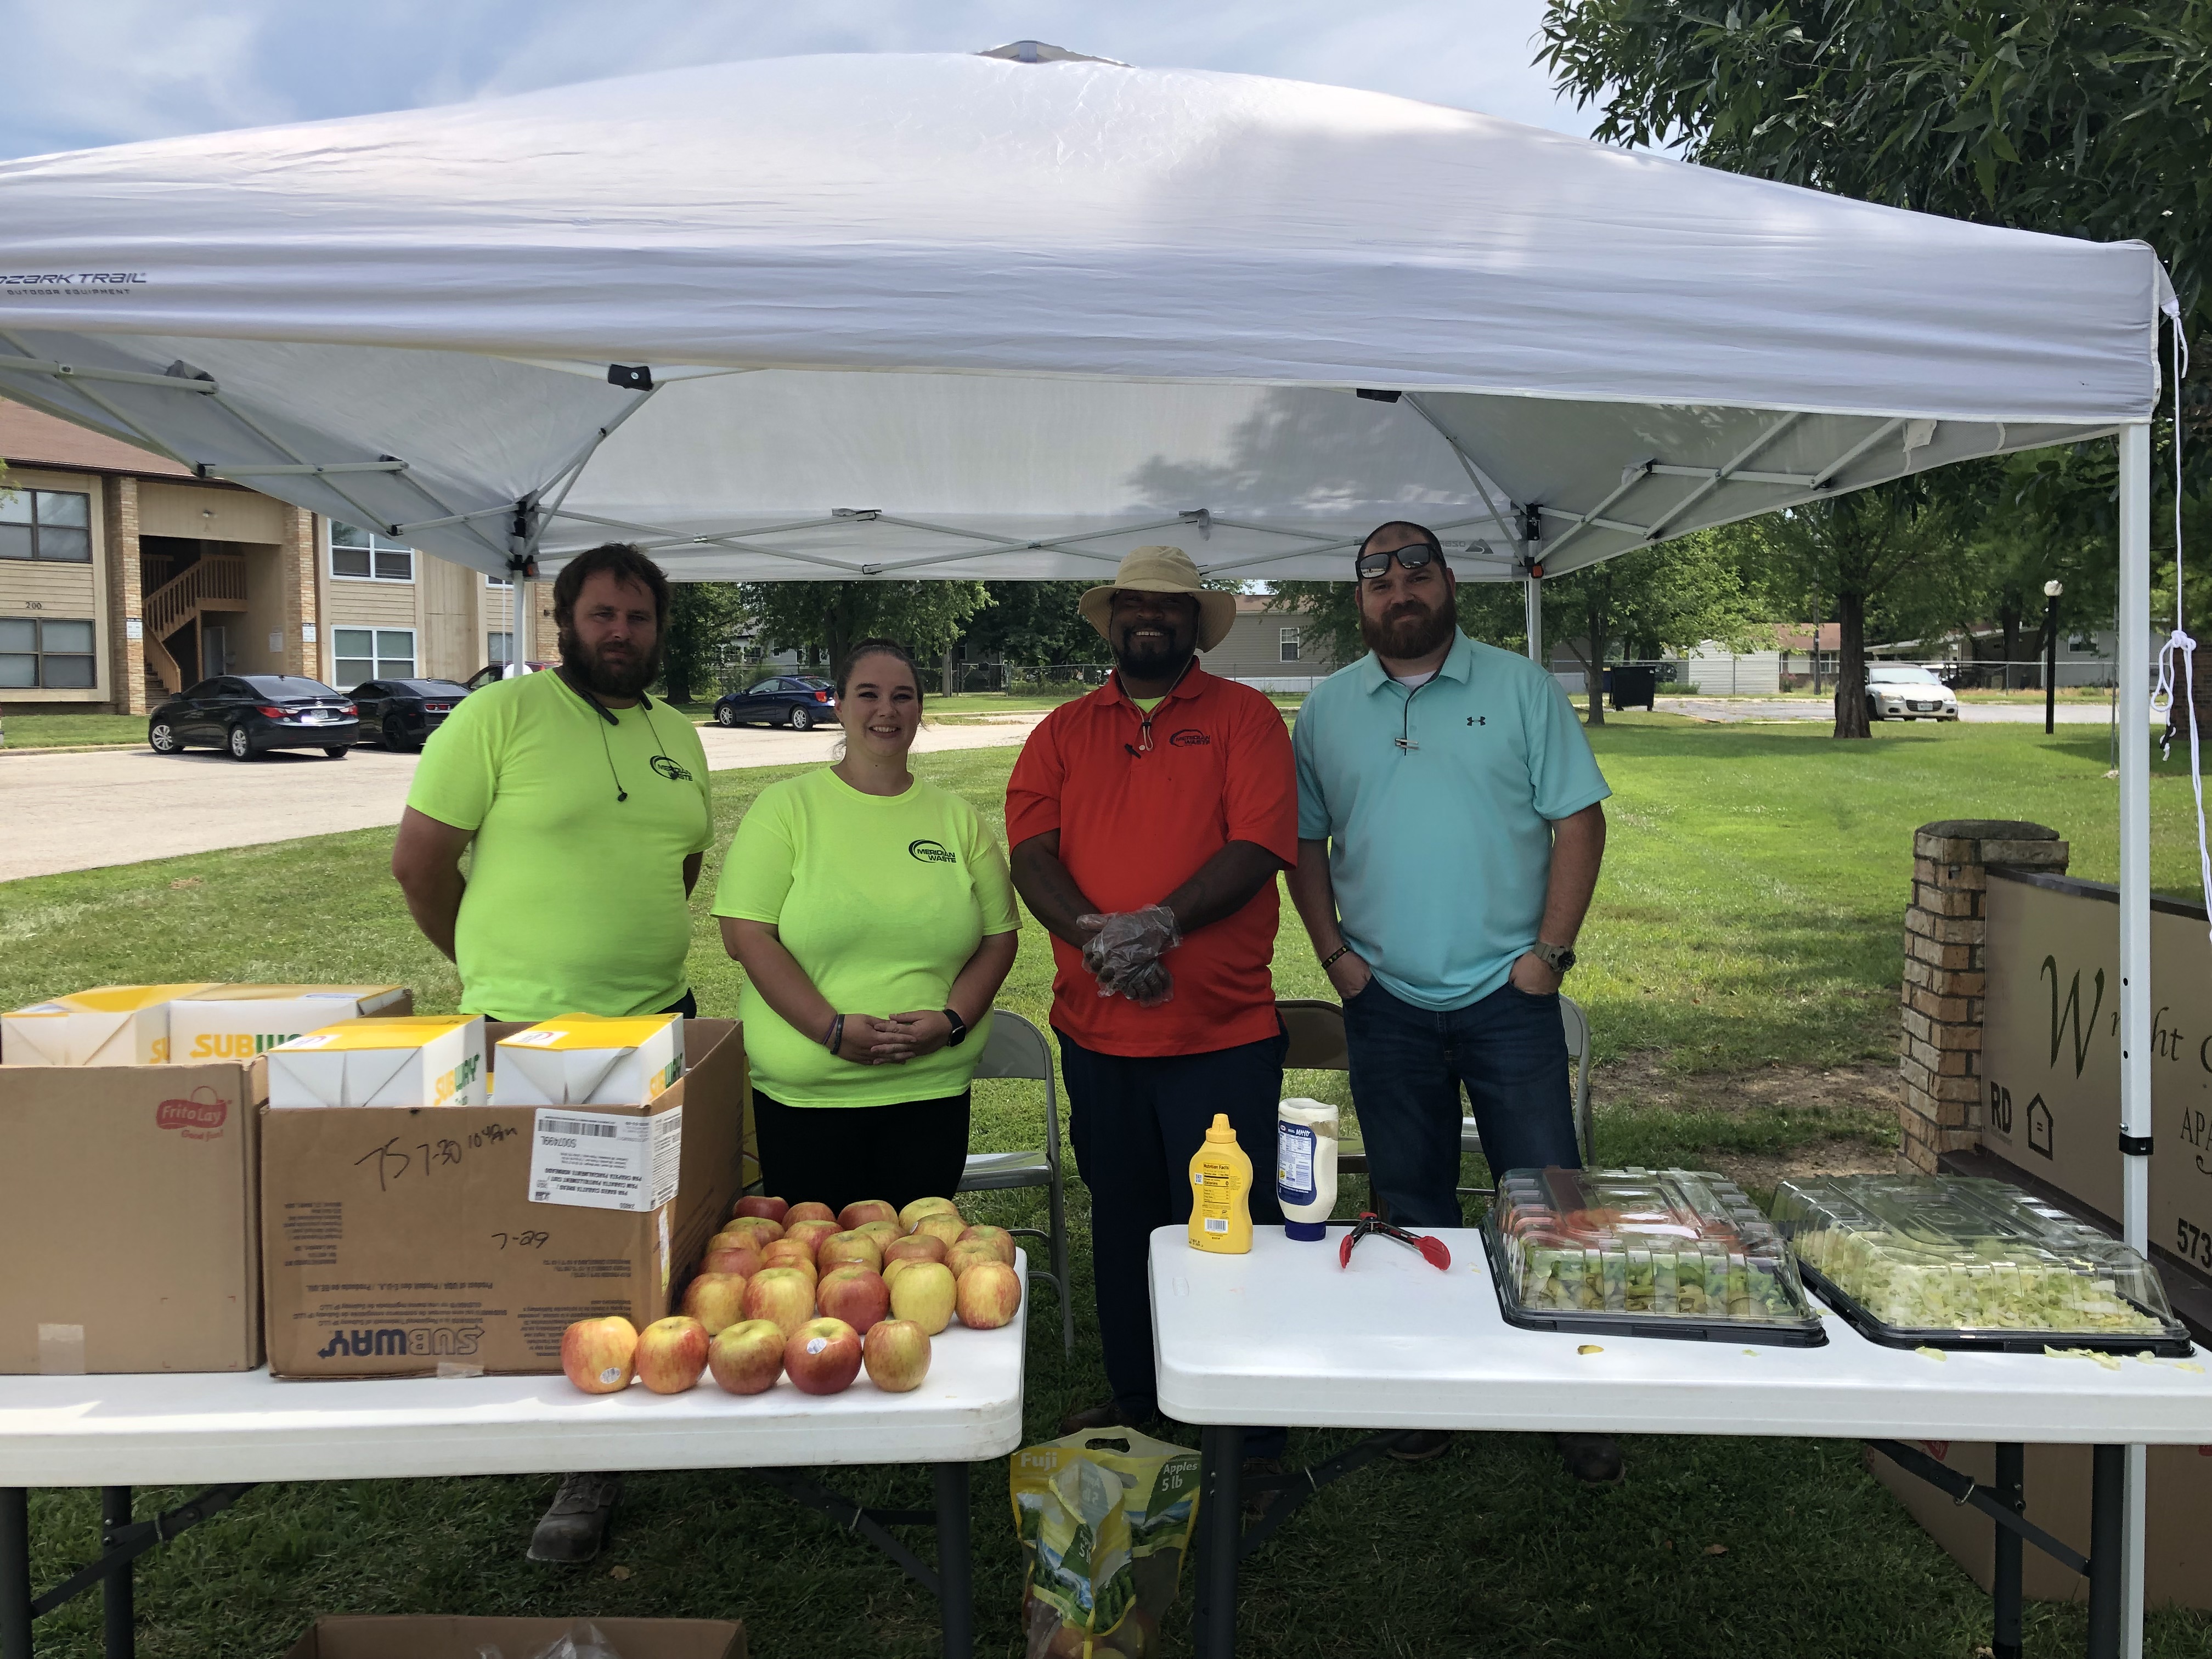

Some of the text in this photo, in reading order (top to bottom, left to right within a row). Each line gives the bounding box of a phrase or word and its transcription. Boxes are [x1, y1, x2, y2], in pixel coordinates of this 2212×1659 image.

[25, 602, 42, 610] 200
[917, 849, 956, 857] MERIDIAN
[928, 855, 957, 863] WASTE
[2040, 955, 2184, 1079] Wrht
[1990, 1080, 2012, 1135] RD
[1295, 1128, 1311, 1137] MAYO
[317, 1325, 484, 1359] SUBWAY
[1021, 1452, 1057, 1471] Fuji
[1164, 1462, 1198, 1476] Apples
[1161, 1475, 1183, 1492] 5 lb
